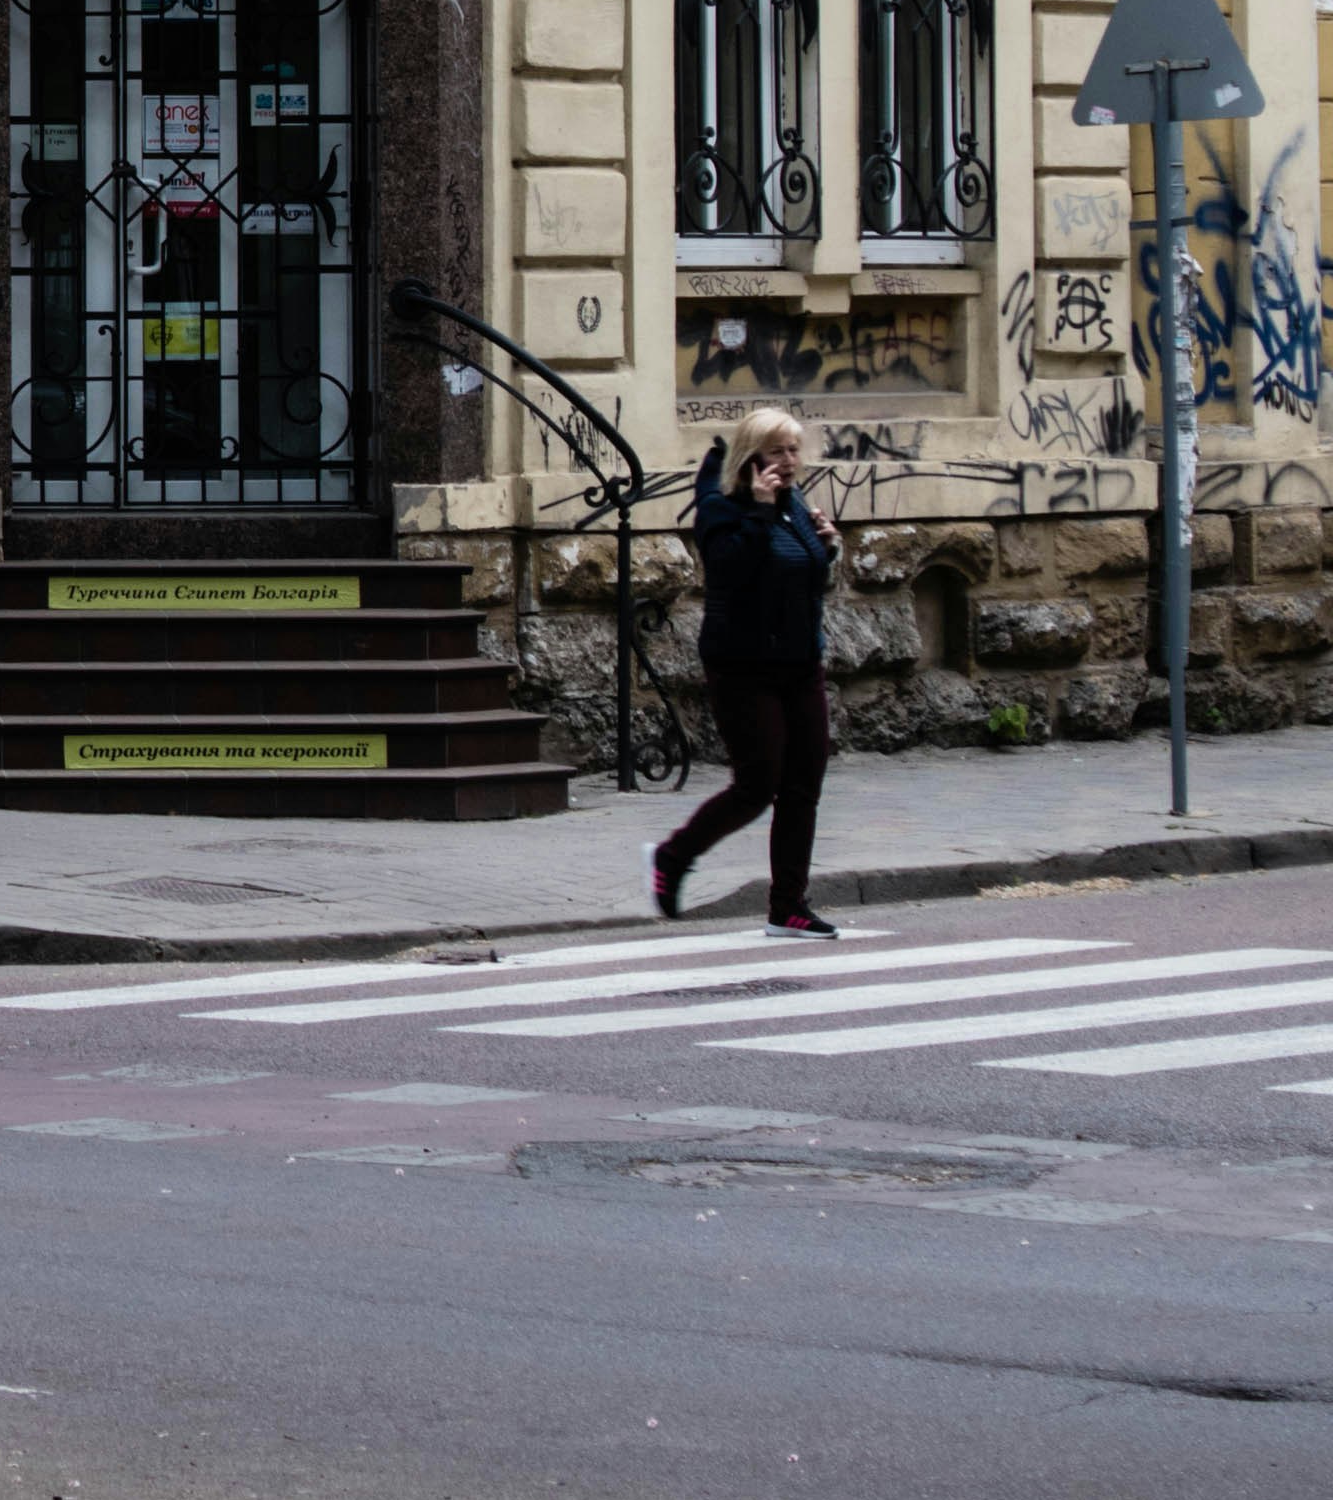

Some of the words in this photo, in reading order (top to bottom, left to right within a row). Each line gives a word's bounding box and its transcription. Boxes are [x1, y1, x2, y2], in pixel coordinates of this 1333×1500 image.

[66, 584, 168, 603] Туреччина
[174, 584, 247, 601] Єгипет
[252, 584, 339, 602] Болгарія
[79, 742, 220, 761] Страхування
[225, 745, 256, 759] та
[262, 741, 370, 760] ксерокопії
